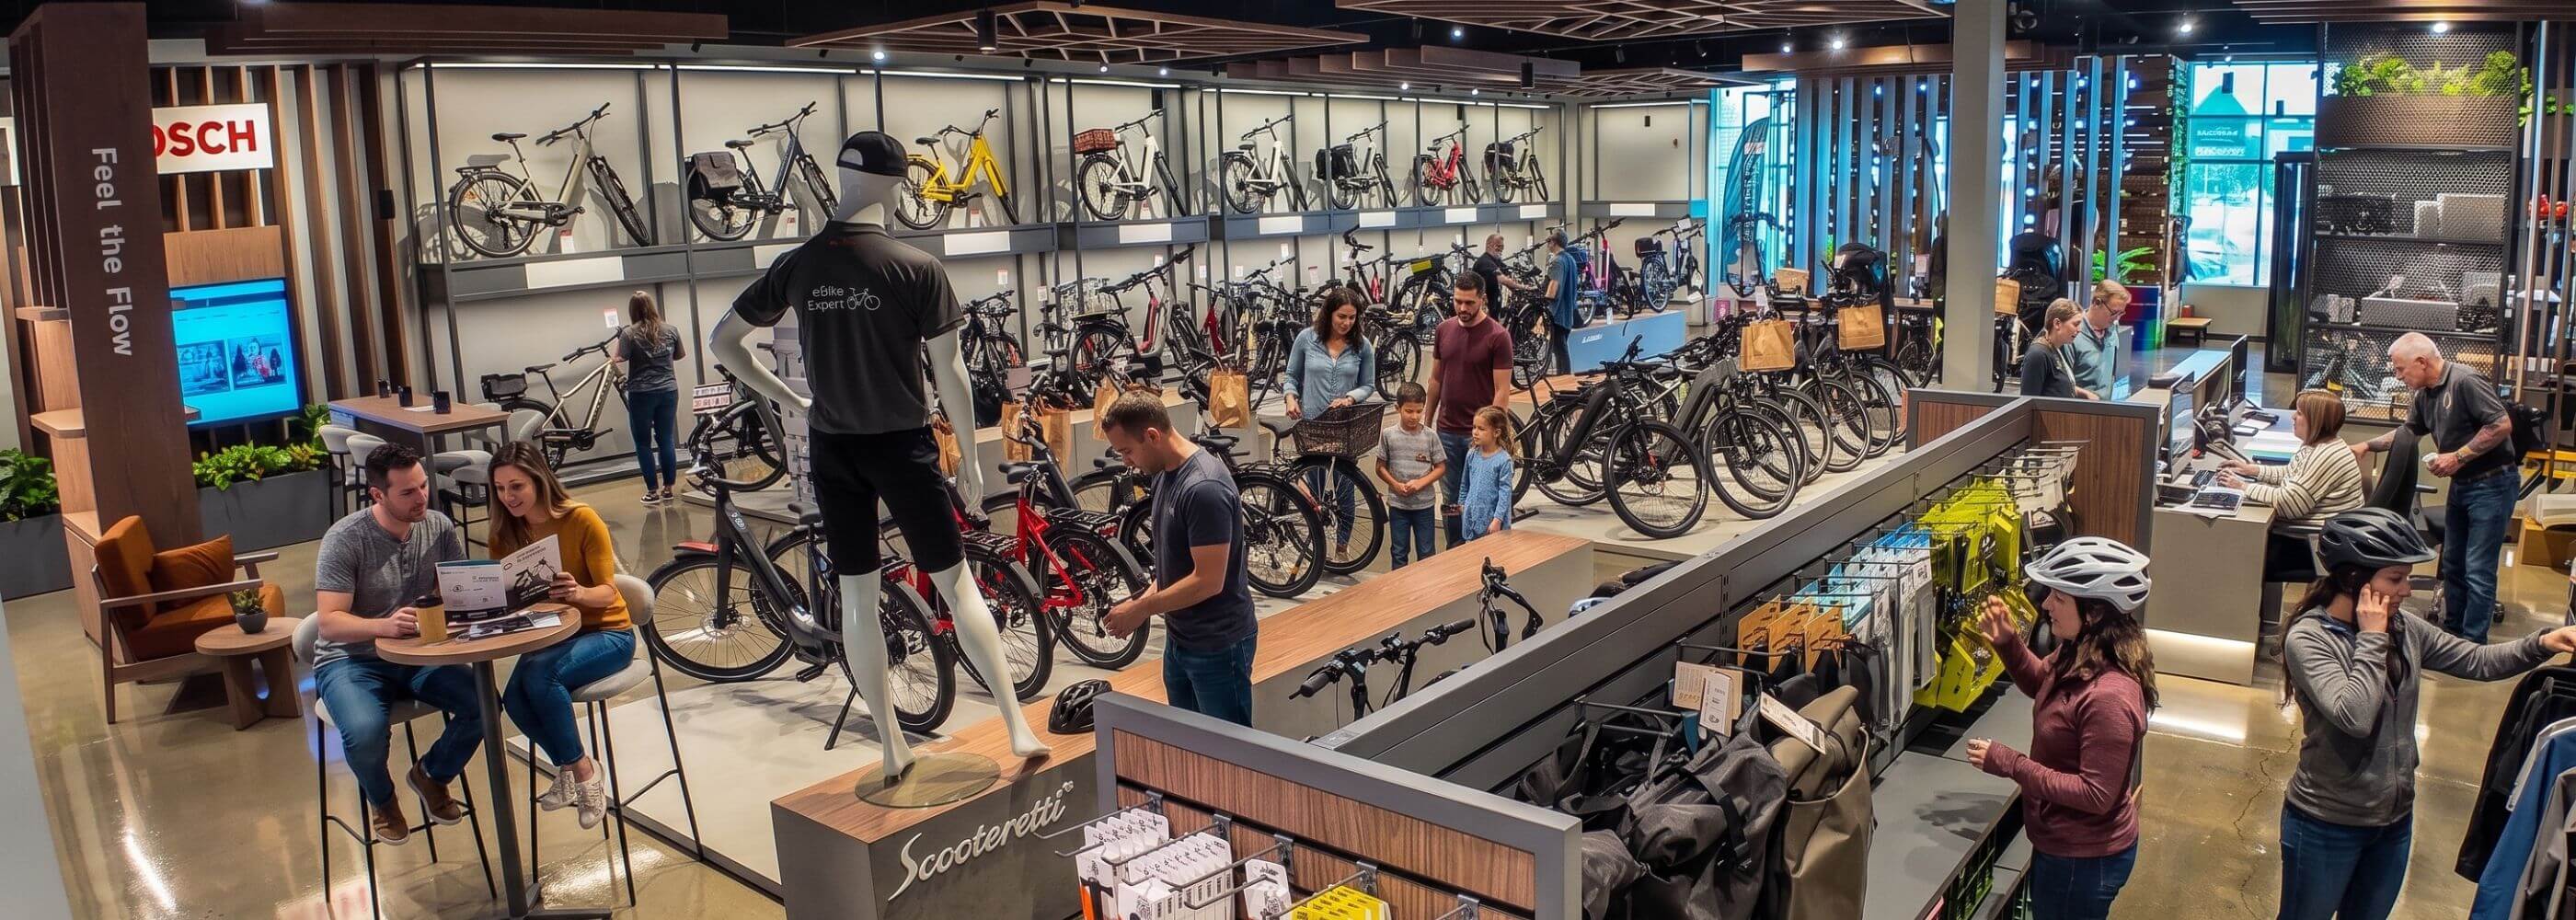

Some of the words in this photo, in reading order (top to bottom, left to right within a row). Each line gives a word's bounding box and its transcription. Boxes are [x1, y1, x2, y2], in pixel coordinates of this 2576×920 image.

[92, 147, 122, 211] Feel
[100, 224, 126, 274] the
[808, 300, 845, 313] Expert
[812, 285, 845, 298] eBike
[106, 286, 133, 357] Flow
[887, 788, 1066, 902] Scooteretti
